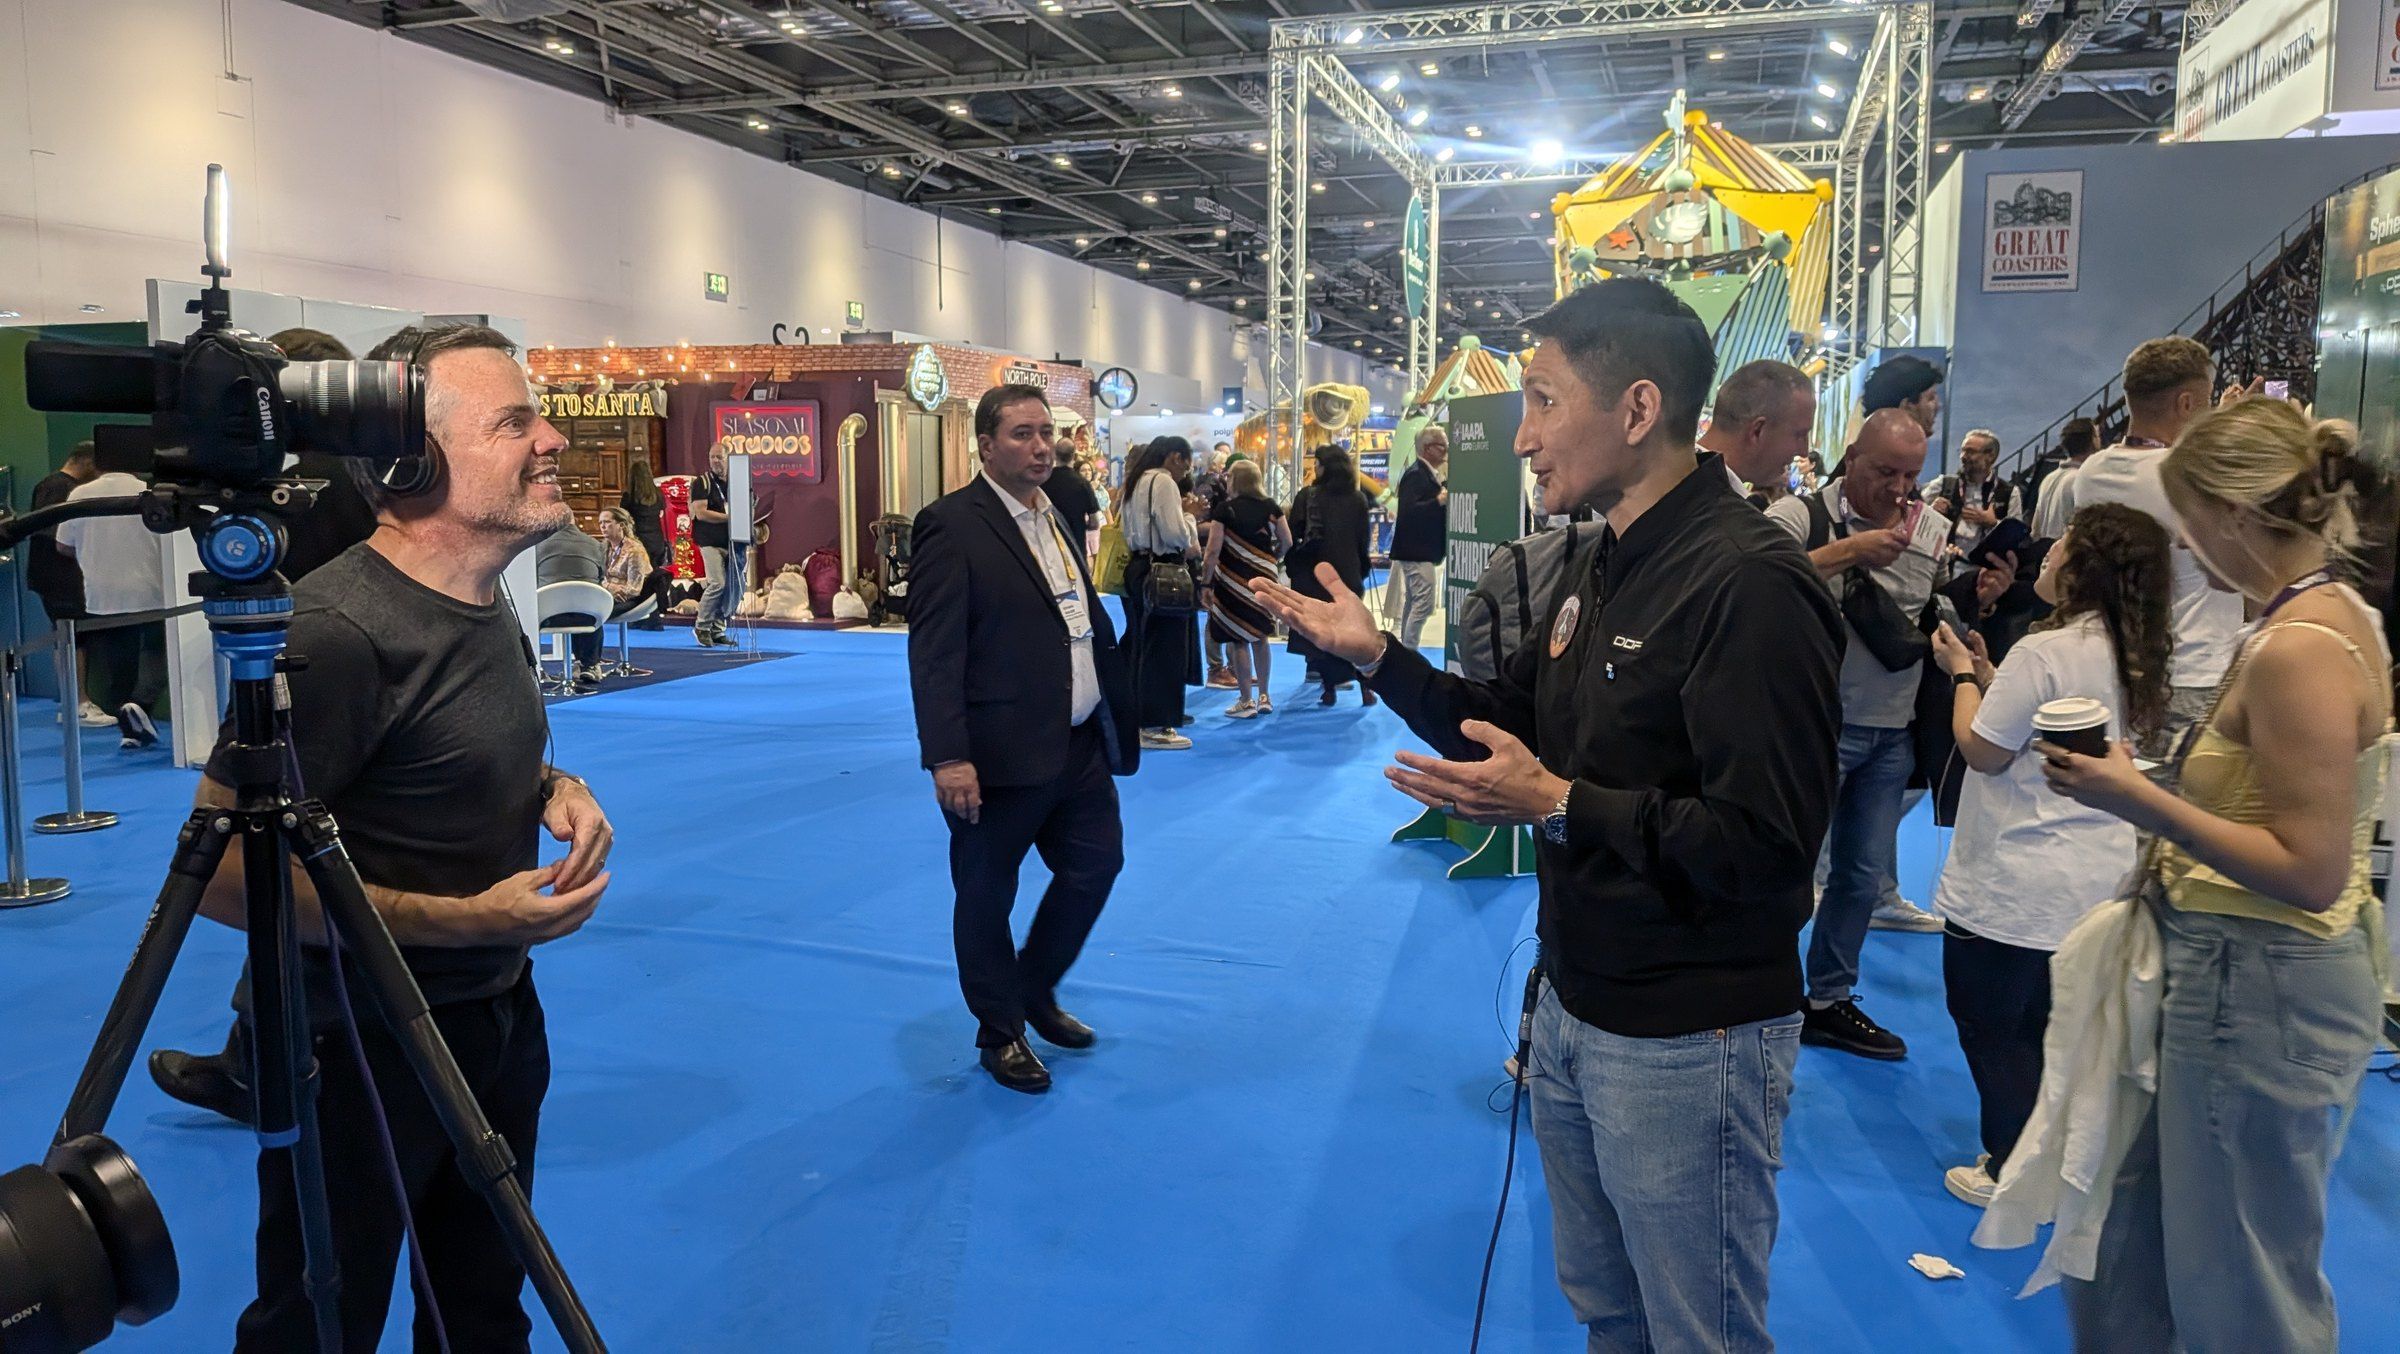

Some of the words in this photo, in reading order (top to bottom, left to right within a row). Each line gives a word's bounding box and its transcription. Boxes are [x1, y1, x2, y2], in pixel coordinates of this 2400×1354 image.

[2215, 43, 2261, 125] GREAT
[2261, 28, 2315, 94] COASTERS
[1995, 229, 2070, 256] GREAT
[1993, 256, 2068, 273] COASTERS
[1004, 369, 1029, 385] NORTH
[1030, 373, 1047, 389] POLE
[257, 387, 274, 440] Canon
[553, 394, 581, 416] TO
[583, 393, 655, 416] SANTA
[1461, 422, 1485, 440] IAAPA
[722, 435, 811, 455] STUDIOS
[1449, 492, 1478, 534] MORE
[1449, 539, 1496, 583] EXHIBIT
[1448, 585, 1470, 626] TH
[1, 1302, 42, 1328] SONY
